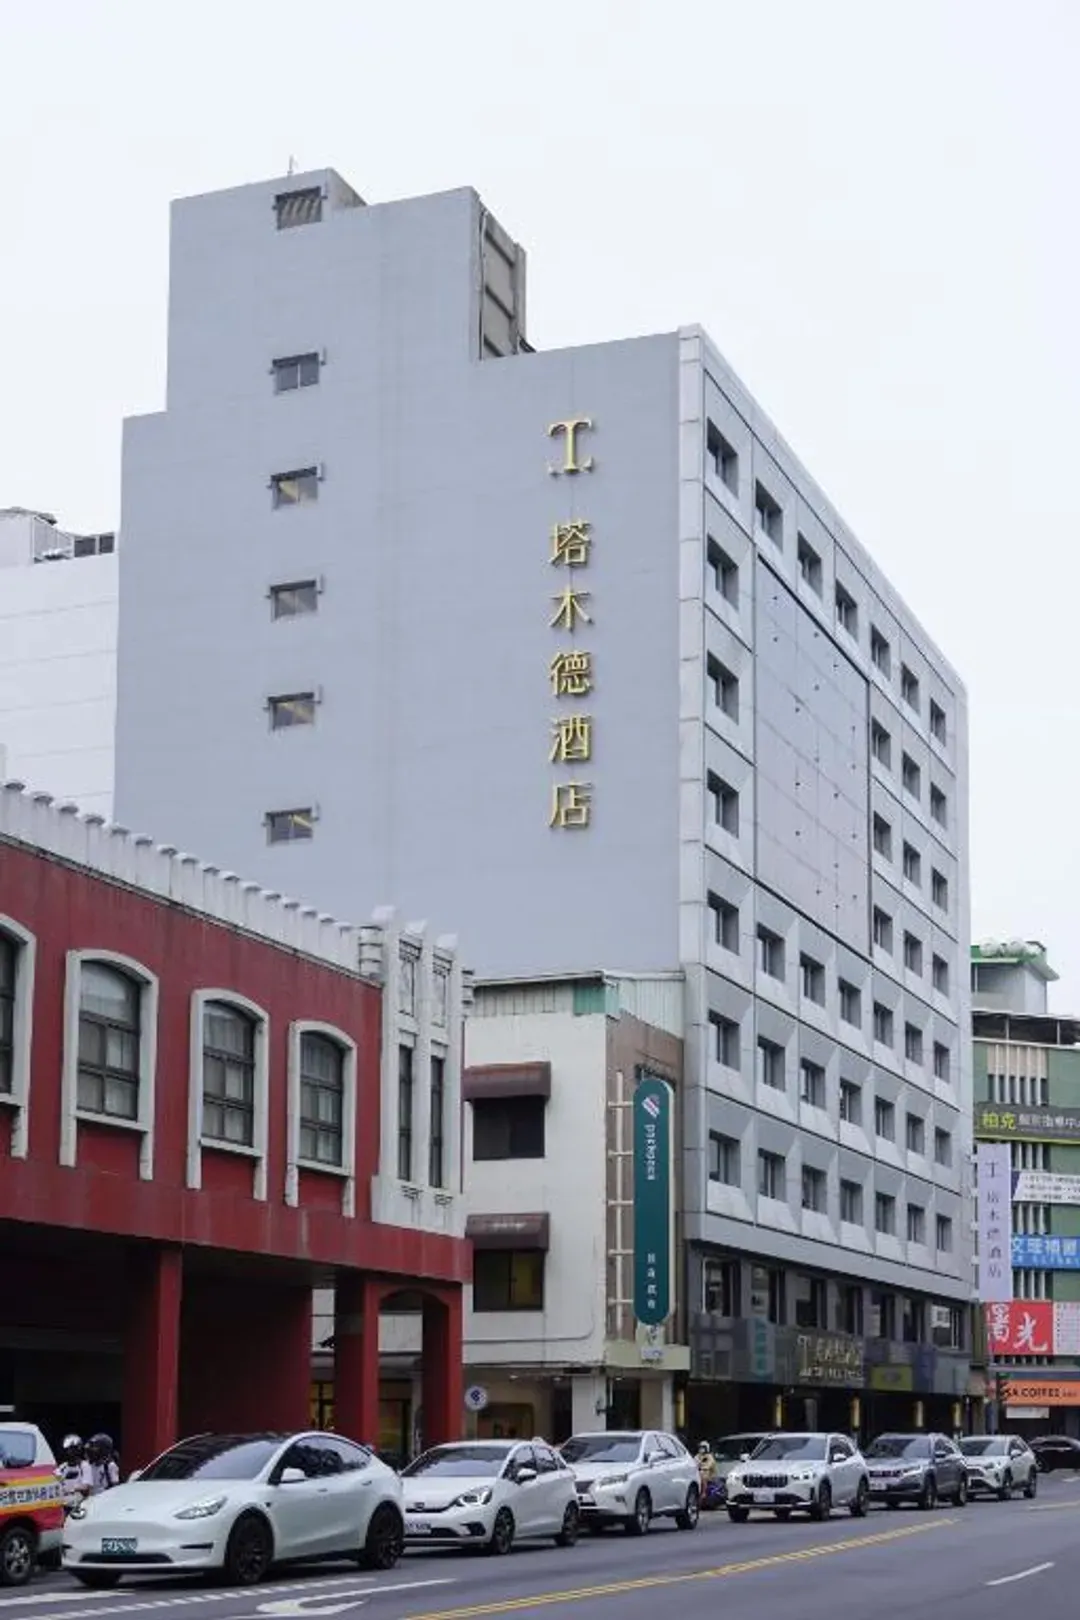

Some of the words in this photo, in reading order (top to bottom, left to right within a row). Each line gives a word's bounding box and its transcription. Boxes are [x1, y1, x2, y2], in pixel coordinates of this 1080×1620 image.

[548, 518, 594, 831] 塔木德酒店
